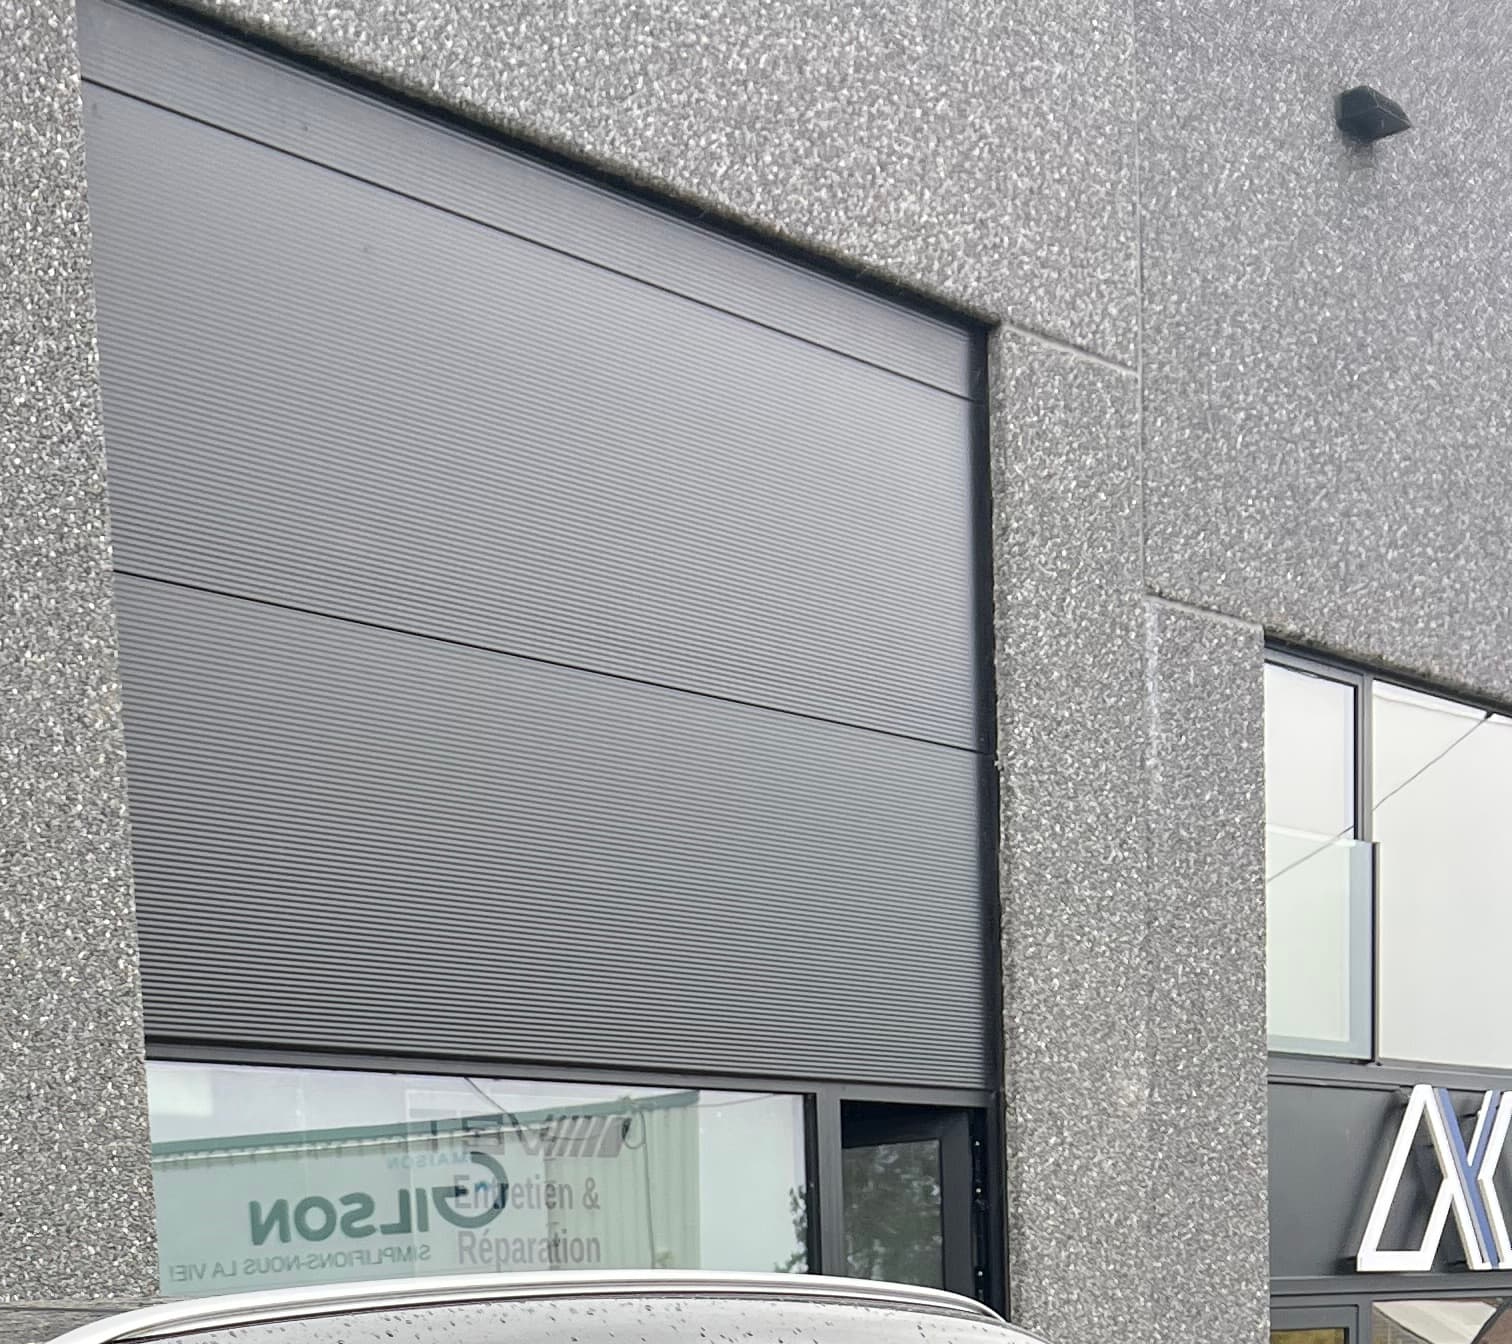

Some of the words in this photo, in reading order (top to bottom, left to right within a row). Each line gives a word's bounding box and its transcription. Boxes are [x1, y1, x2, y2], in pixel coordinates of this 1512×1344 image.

[453, 1174, 573, 1210] Entretien
[582, 1177, 601, 1210] &
[457, 1228, 601, 1272] Réparation
